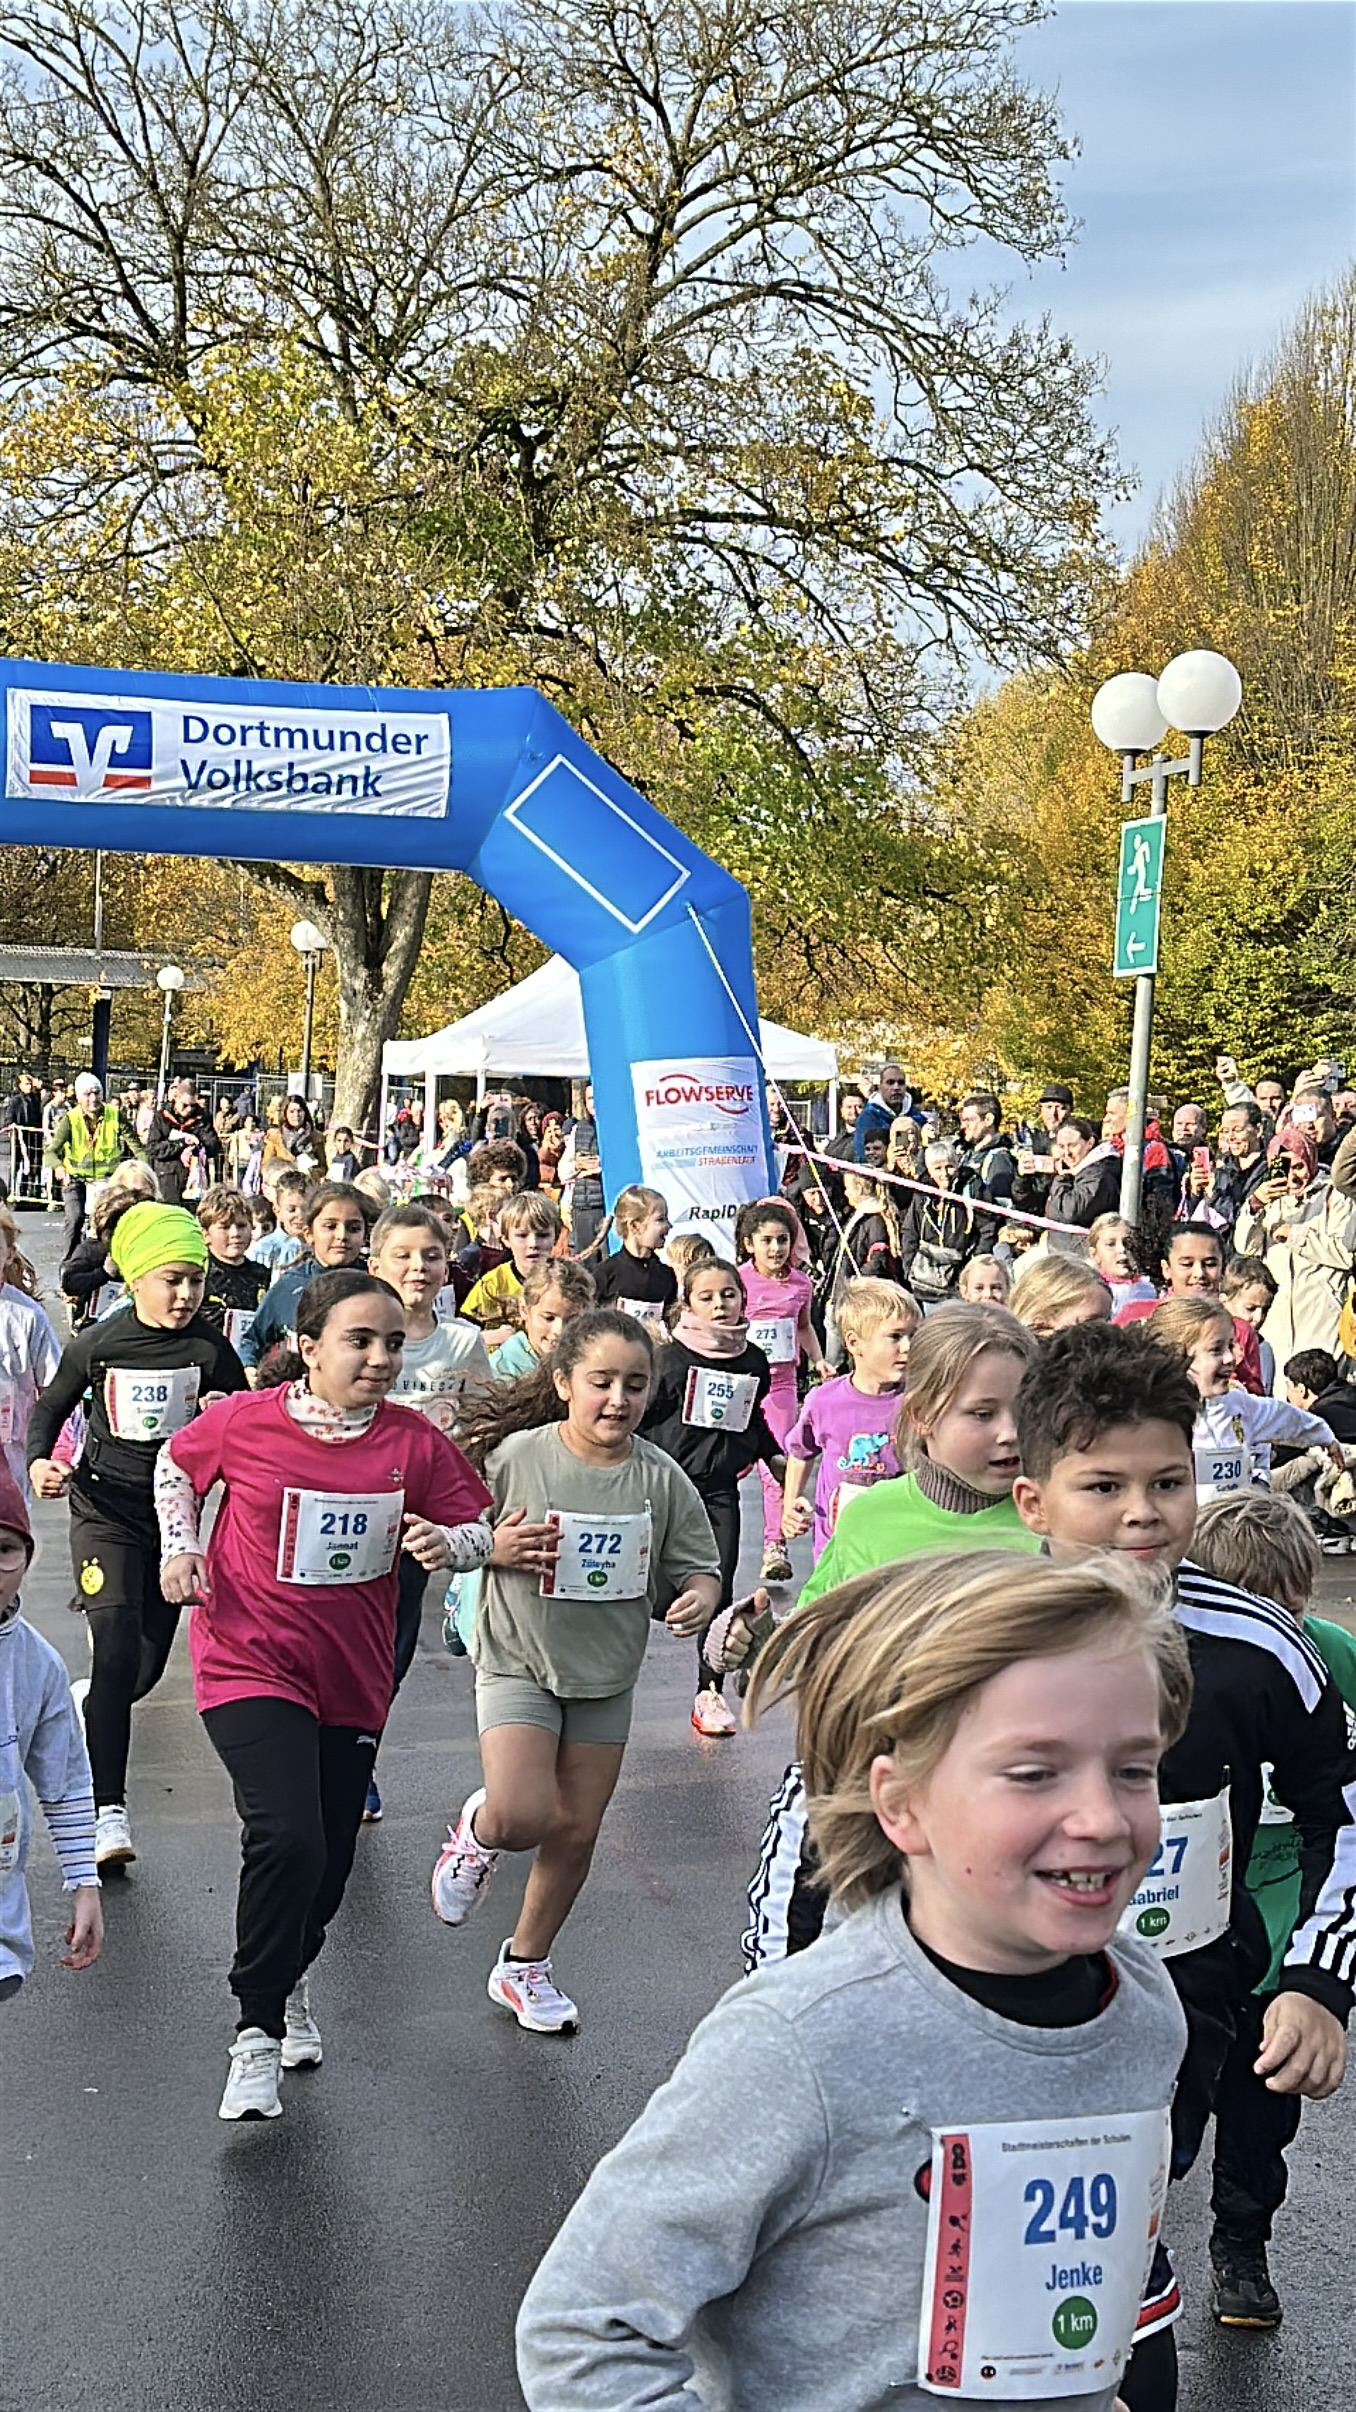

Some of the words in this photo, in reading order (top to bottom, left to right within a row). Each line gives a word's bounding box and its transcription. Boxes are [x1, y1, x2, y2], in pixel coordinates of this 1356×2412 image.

[182, 714, 430, 755] Dortmunder
[181, 758, 383, 798] Volksbank
[645, 1084, 754, 1107] FLOWSERVE
[755, 1328, 778, 1341] 273
[132, 1385, 168, 1402] 238
[707, 1381, 734, 1400] 255
[1213, 1460, 1241, 1480] 230
[319, 1512, 368, 1536] 218
[578, 1532, 622, 1555] 272
[1140, 1918, 1147, 1930] 1
[1150, 1915, 1168, 1927] km
[1024, 2173, 1117, 2246] 249
[1045, 2261, 1103, 2291] Jenke
[1057, 2315, 1065, 2334] 1
[1071, 2313, 1094, 2330] km
